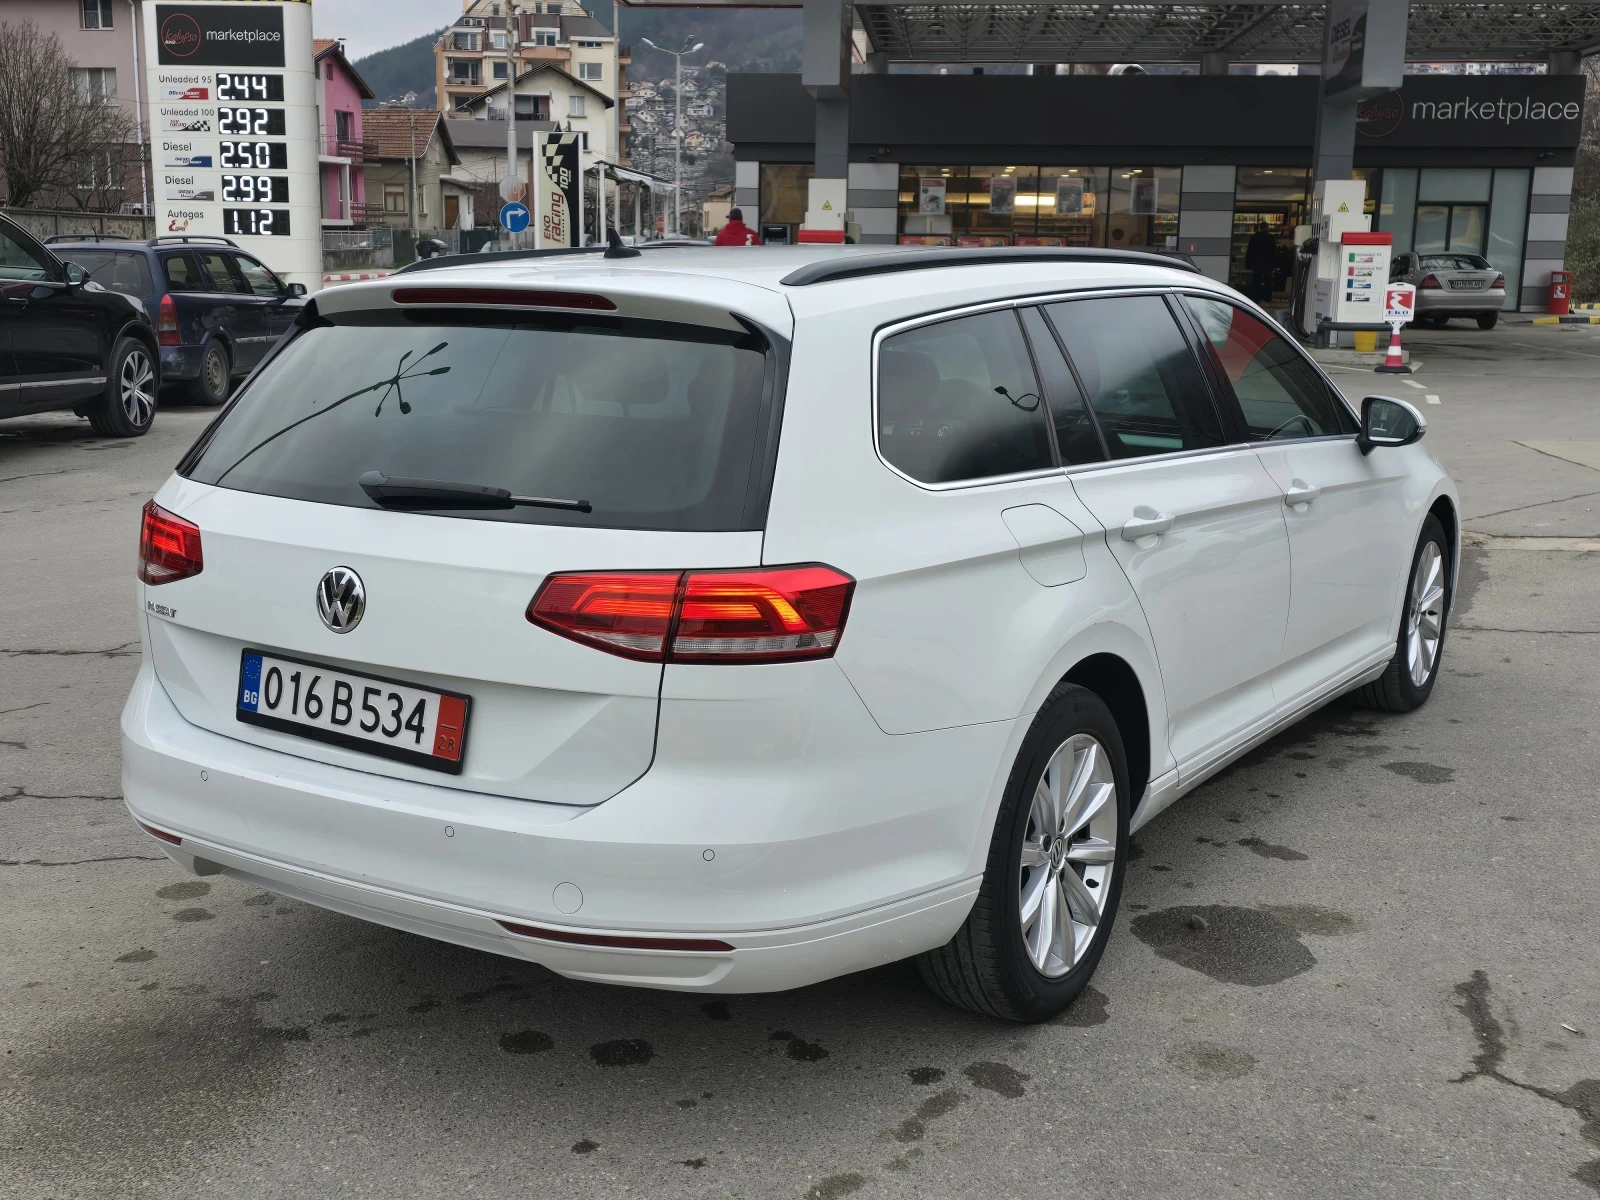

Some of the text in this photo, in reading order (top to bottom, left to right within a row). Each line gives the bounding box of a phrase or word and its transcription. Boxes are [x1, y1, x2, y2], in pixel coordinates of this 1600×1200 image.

[206, 28, 281, 43] marketplace
[158, 74, 212, 84] Unleaded 95
[217, 73, 267, 100] 2.44
[160, 107, 215, 117] Unleaded 100
[219, 107, 269, 135] 2.92
[1412, 96, 1580, 125] marketplace
[163, 142, 192, 152] Diesel
[220, 141, 271, 168] 2.50
[165, 175, 194, 185] Diesel
[223, 175, 273, 202] 2.99
[560, 167, 568, 189] 100
[167, 209, 204, 220] Autogas
[233, 209, 274, 235] 1.12
[551, 191, 565, 243] racing
[543, 214, 551, 239] EKO
[243, 689, 258, 705] BG
[439, 734, 456, 752] 28
